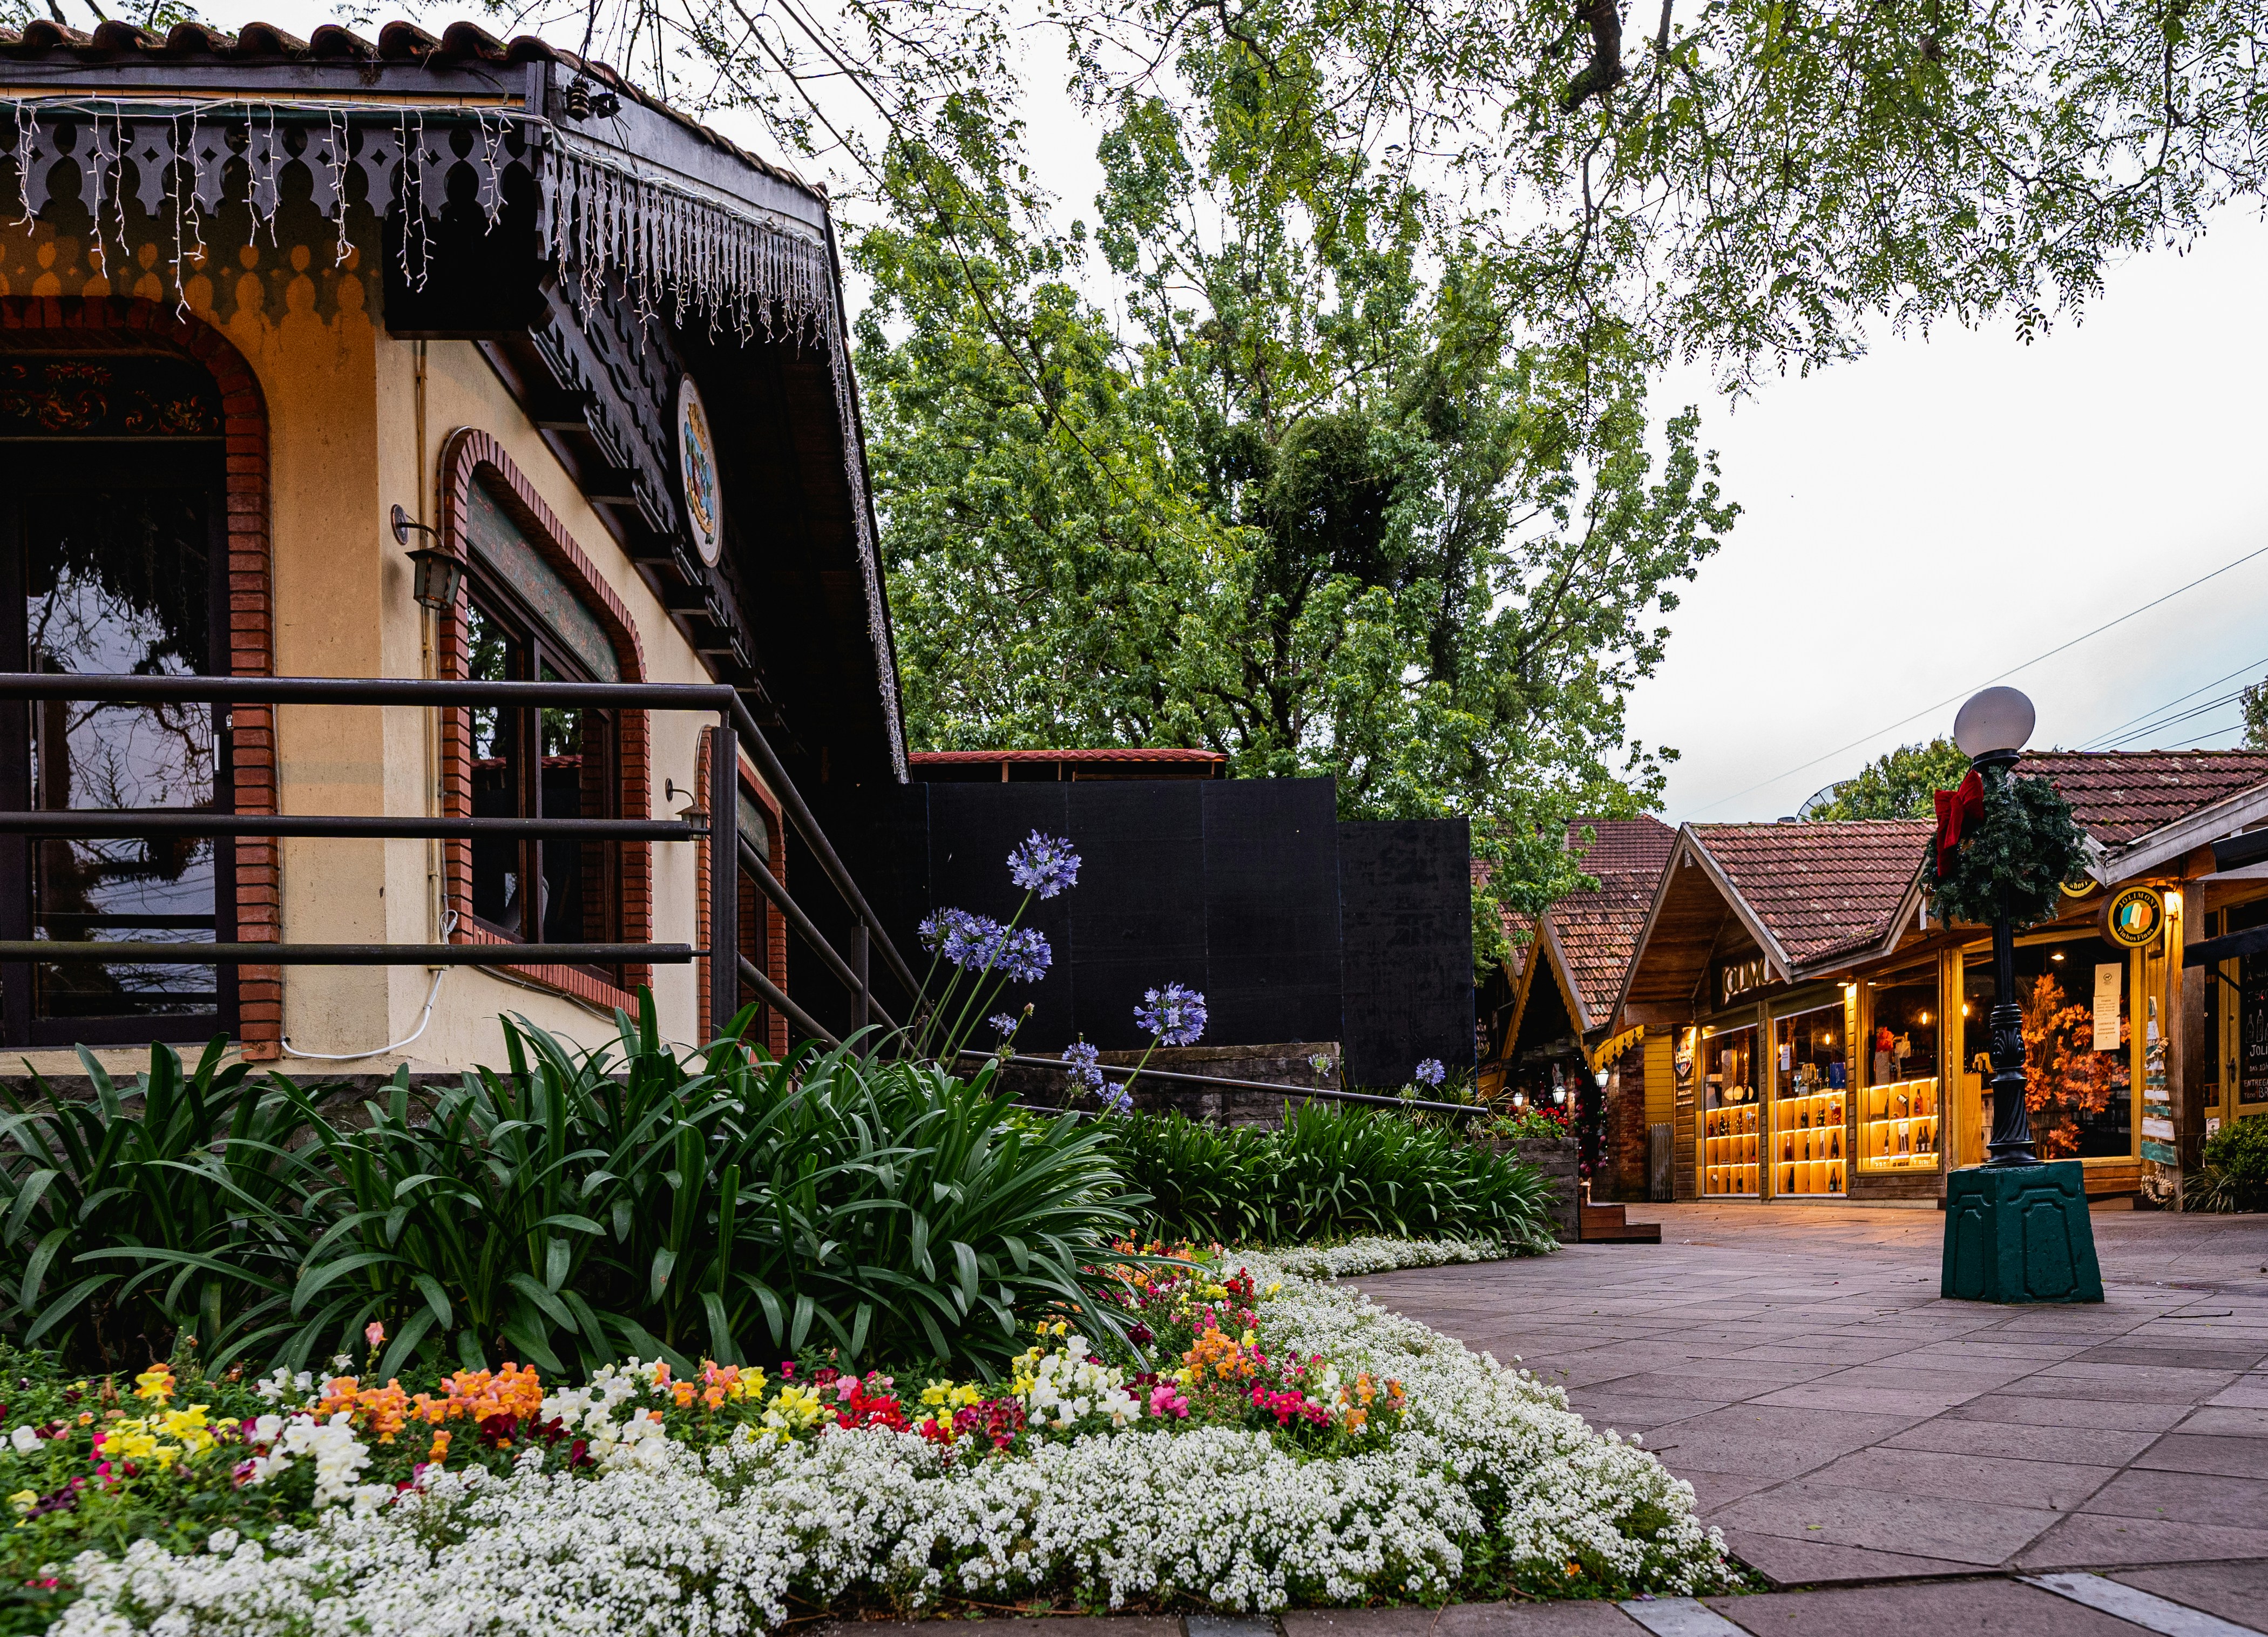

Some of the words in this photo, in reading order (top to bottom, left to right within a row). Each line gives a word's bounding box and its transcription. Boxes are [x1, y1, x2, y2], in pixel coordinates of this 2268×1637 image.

[2118, 892, 2158, 909] JOLIMONT
[2117, 926, 2136, 942] Vinhos
[2137, 928, 2154, 941] Finos
